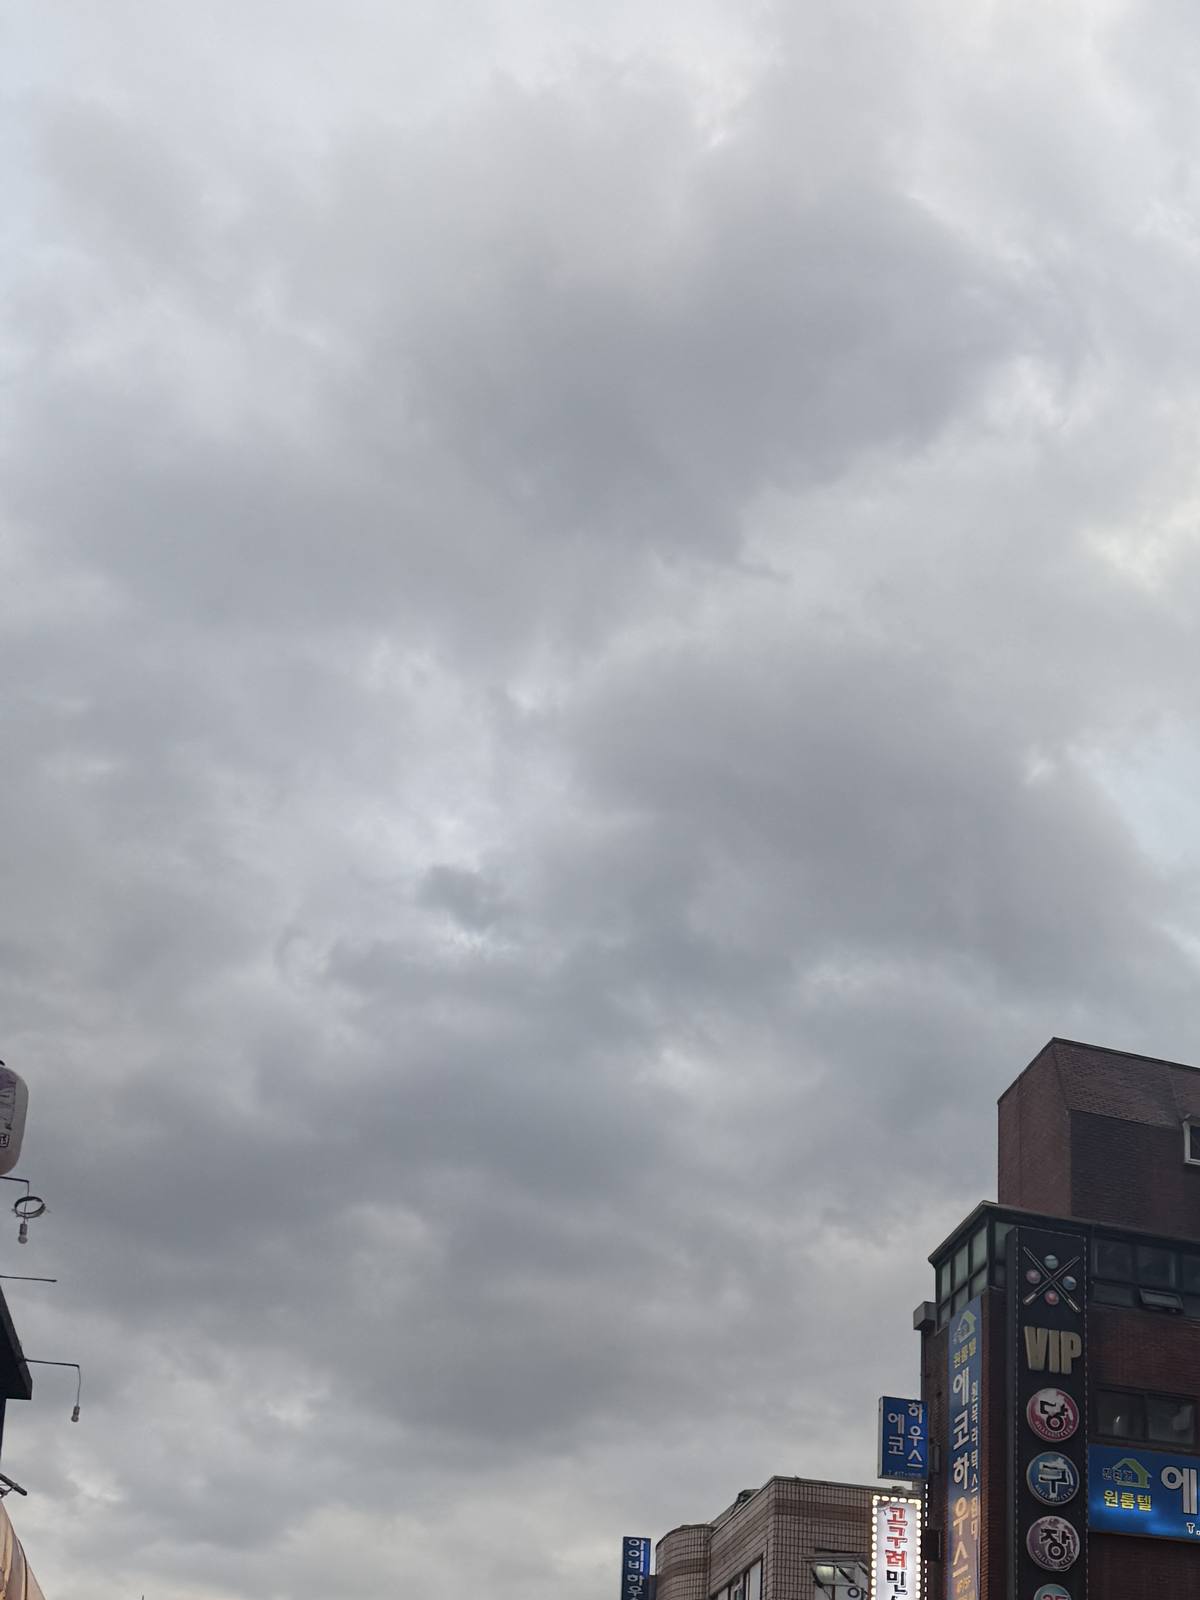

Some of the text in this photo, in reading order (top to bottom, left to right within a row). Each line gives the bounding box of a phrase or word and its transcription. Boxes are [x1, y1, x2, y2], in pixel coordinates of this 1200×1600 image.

[1024, 1326, 1082, 1374] VIP
[888, 1413, 904, 1455] 에코
[907, 1402, 924, 1468] 하우스
[1038, 1399, 1071, 1557] 당구장
[1104, 1489, 1152, 1511] 원룸텔
